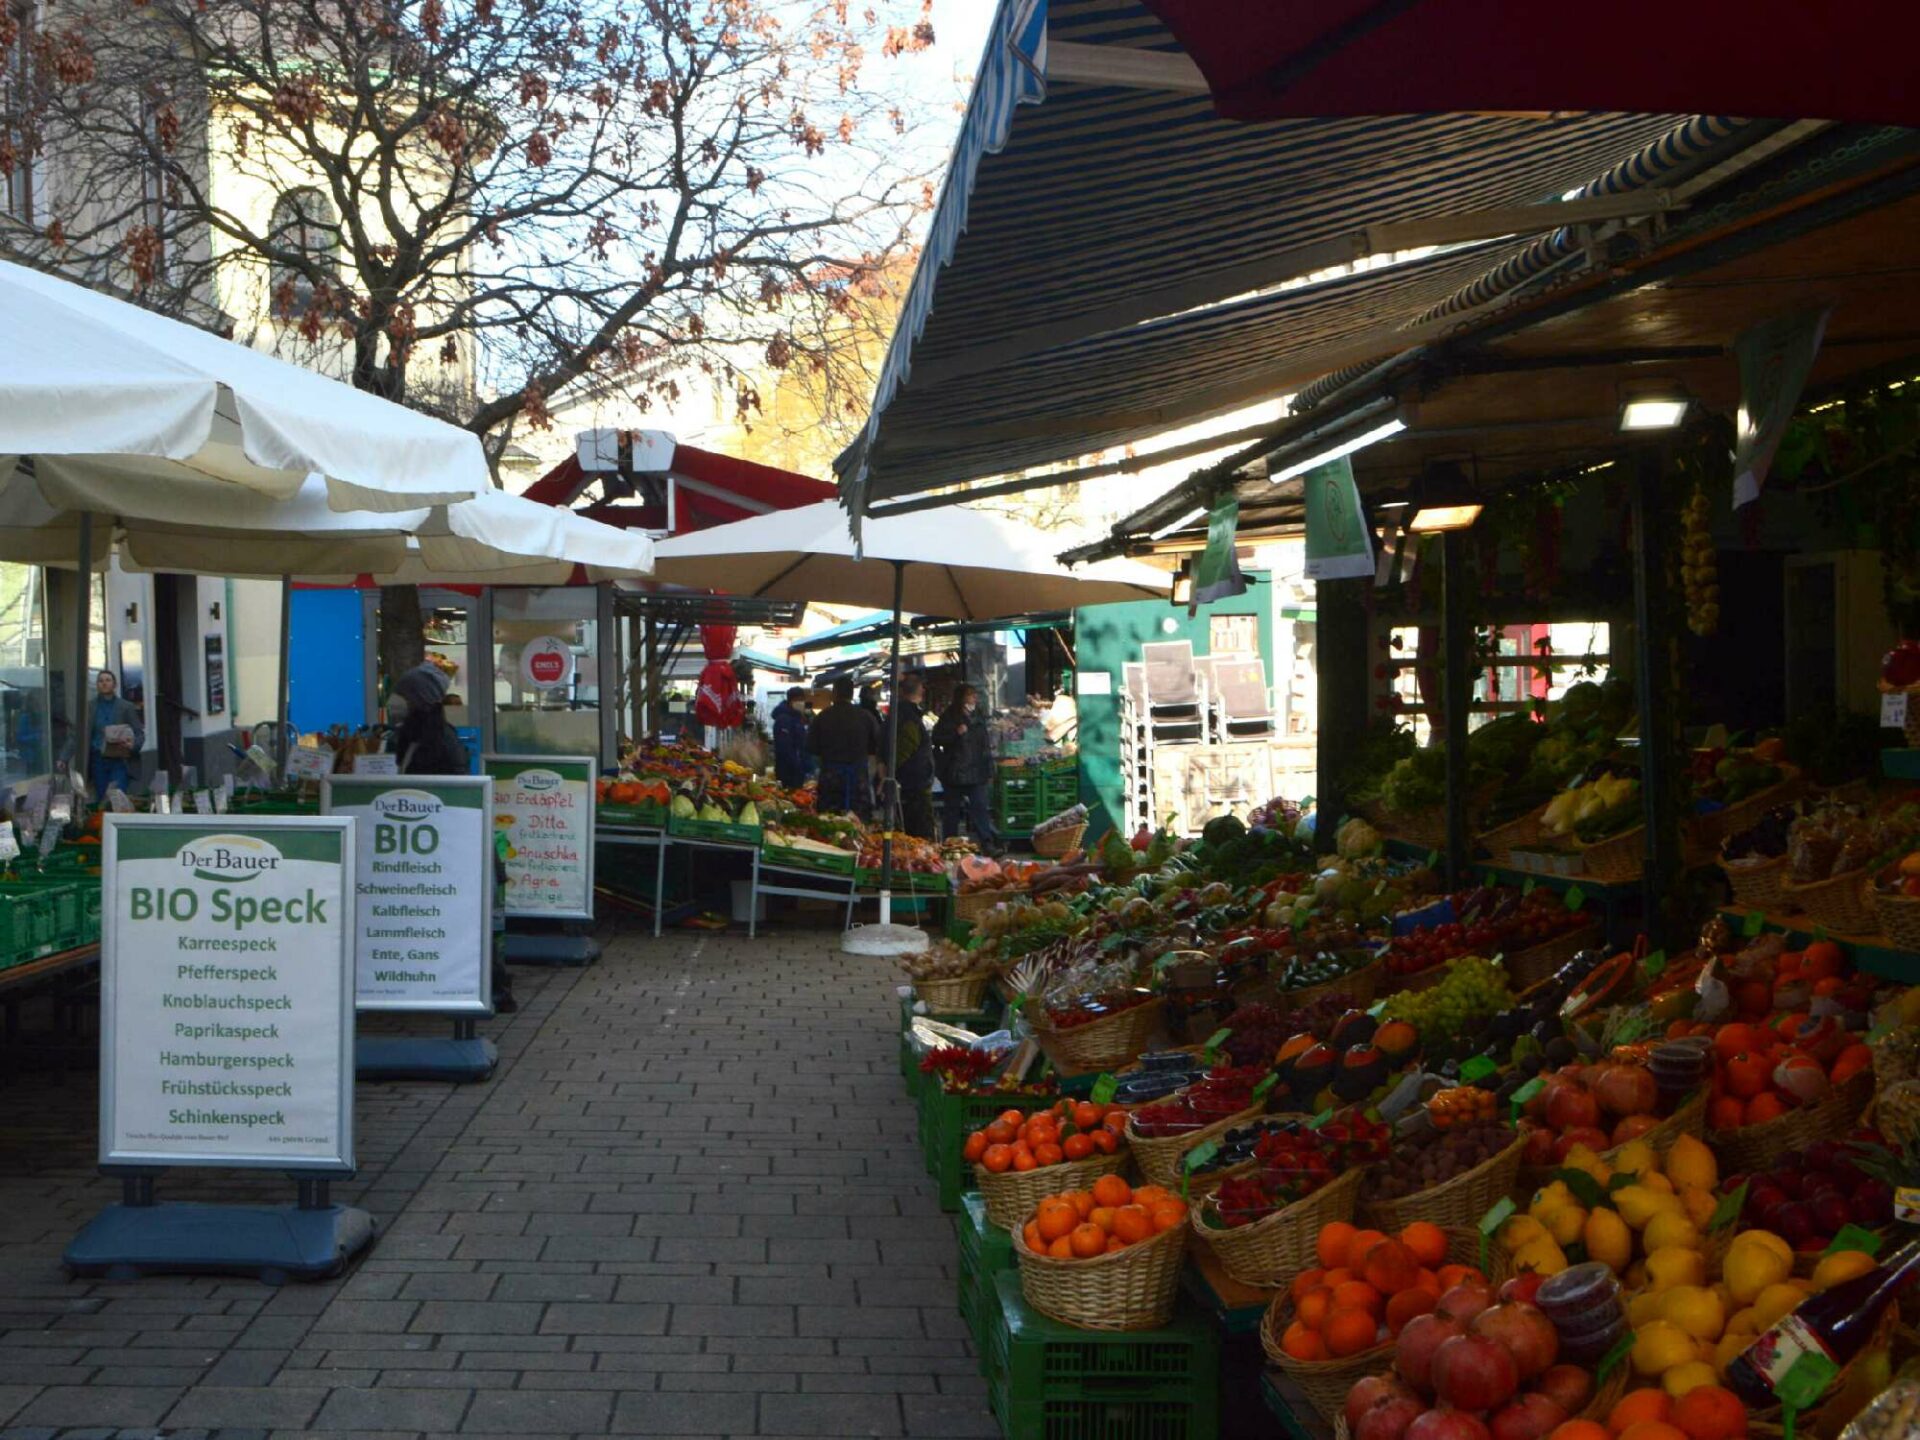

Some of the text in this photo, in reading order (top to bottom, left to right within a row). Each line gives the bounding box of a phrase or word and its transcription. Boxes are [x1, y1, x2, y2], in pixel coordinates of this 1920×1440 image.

[375, 798, 442, 813] Der Bauer
[528, 814, 568, 829] Ditta
[374, 824, 439, 855] BIO
[181, 848, 279, 870] Der Bauer
[518, 845, 578, 861] Anuschka
[372, 860, 442, 874] Rindfleisch
[521, 873, 560, 888] Agria
[356, 883, 457, 896] Schweinefleisch
[130, 887, 328, 931] BIO Speck
[372, 905, 441, 917] Kalbfleisch
[366, 927, 446, 939] Lammfleisch
[177, 935, 278, 954] Karreespeck
[372, 949, 440, 962] Ente, Gans
[177, 964, 278, 982] Pfefferspeck
[374, 971, 436, 983] Wildhuhn
[162, 992, 292, 1012] Knoblauchspeck
[174, 1022, 279, 1040] Paprikaspeck
[160, 1050, 295, 1070] Hamburgerspeck
[161, 1079, 292, 1099] Frühstücksspeck
[169, 1108, 286, 1127] Schinkenspeck
